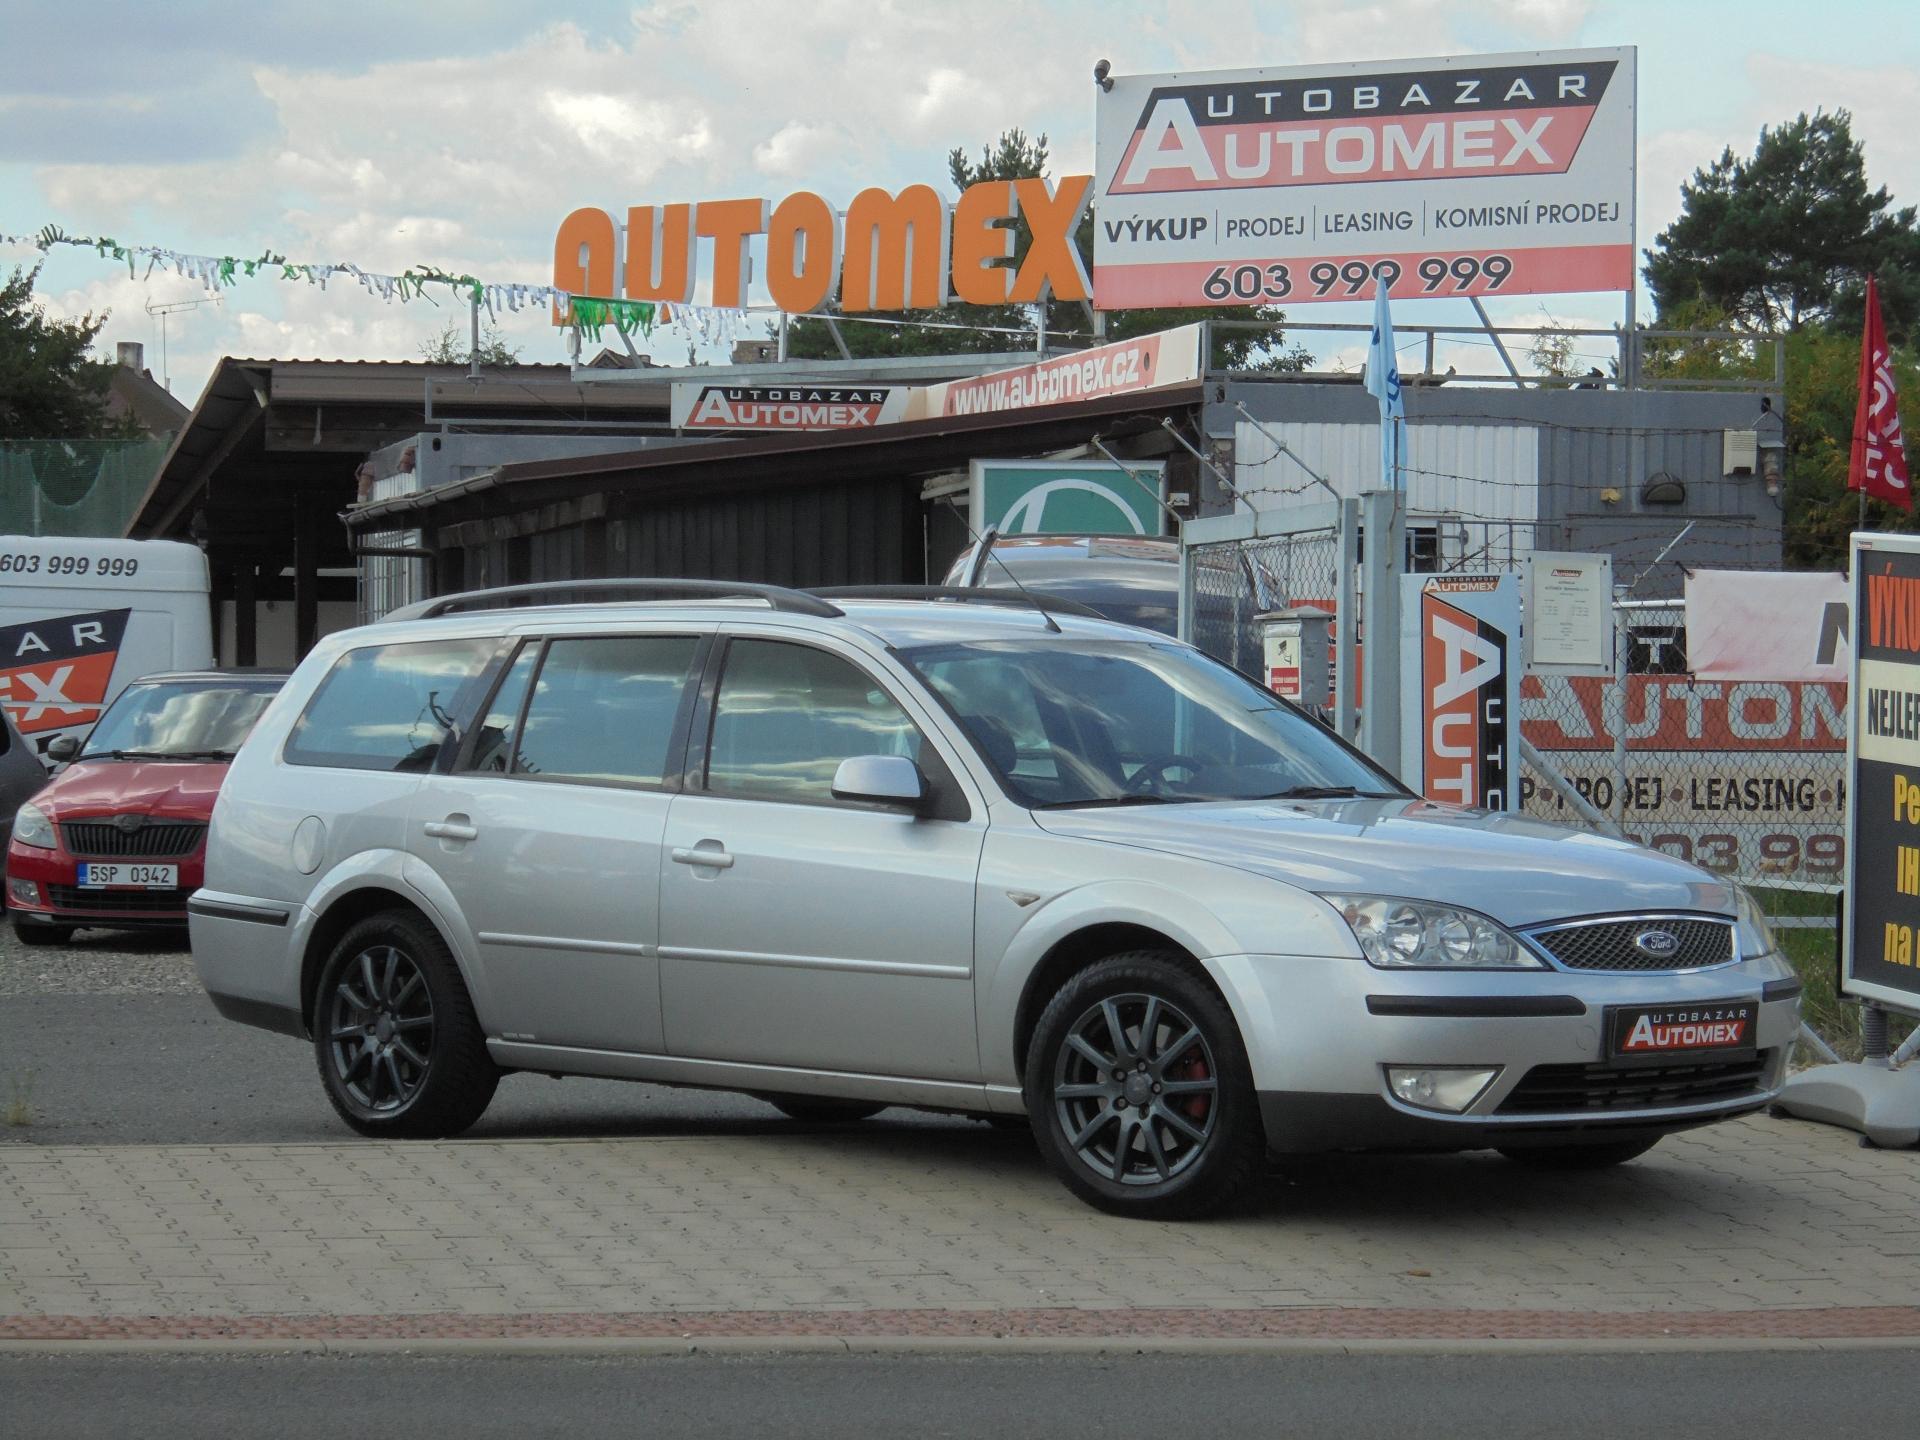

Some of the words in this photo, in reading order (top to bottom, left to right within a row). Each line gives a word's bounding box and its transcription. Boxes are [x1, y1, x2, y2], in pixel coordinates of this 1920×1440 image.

[1122, 98, 1554, 185] AUTOMEX
[1104, 214, 1208, 243] VÝKUP
[1226, 216, 1305, 238] PRODEJ
[1324, 211, 1413, 234] LEASING
[1435, 199, 1531, 229] KOMISNÍ
[1536, 202, 1619, 224] PRODEJ
[552, 174, 1095, 327] AUTOMEX
[1202, 264, 1292, 301] 603
[1309, 259, 1402, 297] 999
[1418, 254, 1513, 293] 999
[955, 348, 1139, 416] www.automex.cz
[694, 389, 874, 425] AUTOMEX
[0, 554, 40, 573] 603
[48, 556, 90, 575] 999
[96, 558, 138, 577] 999
[1424, 577, 1495, 592] AUTOMEX
[1692, 778, 1815, 811] LEASING
[90, 867, 118, 882] 5SP
[131, 867, 169, 883] 0342
[1650, 935, 1671, 949] Ford
[1884, 922, 1912, 966] na
[1627, 1014, 1738, 1047] AUTOMEX
